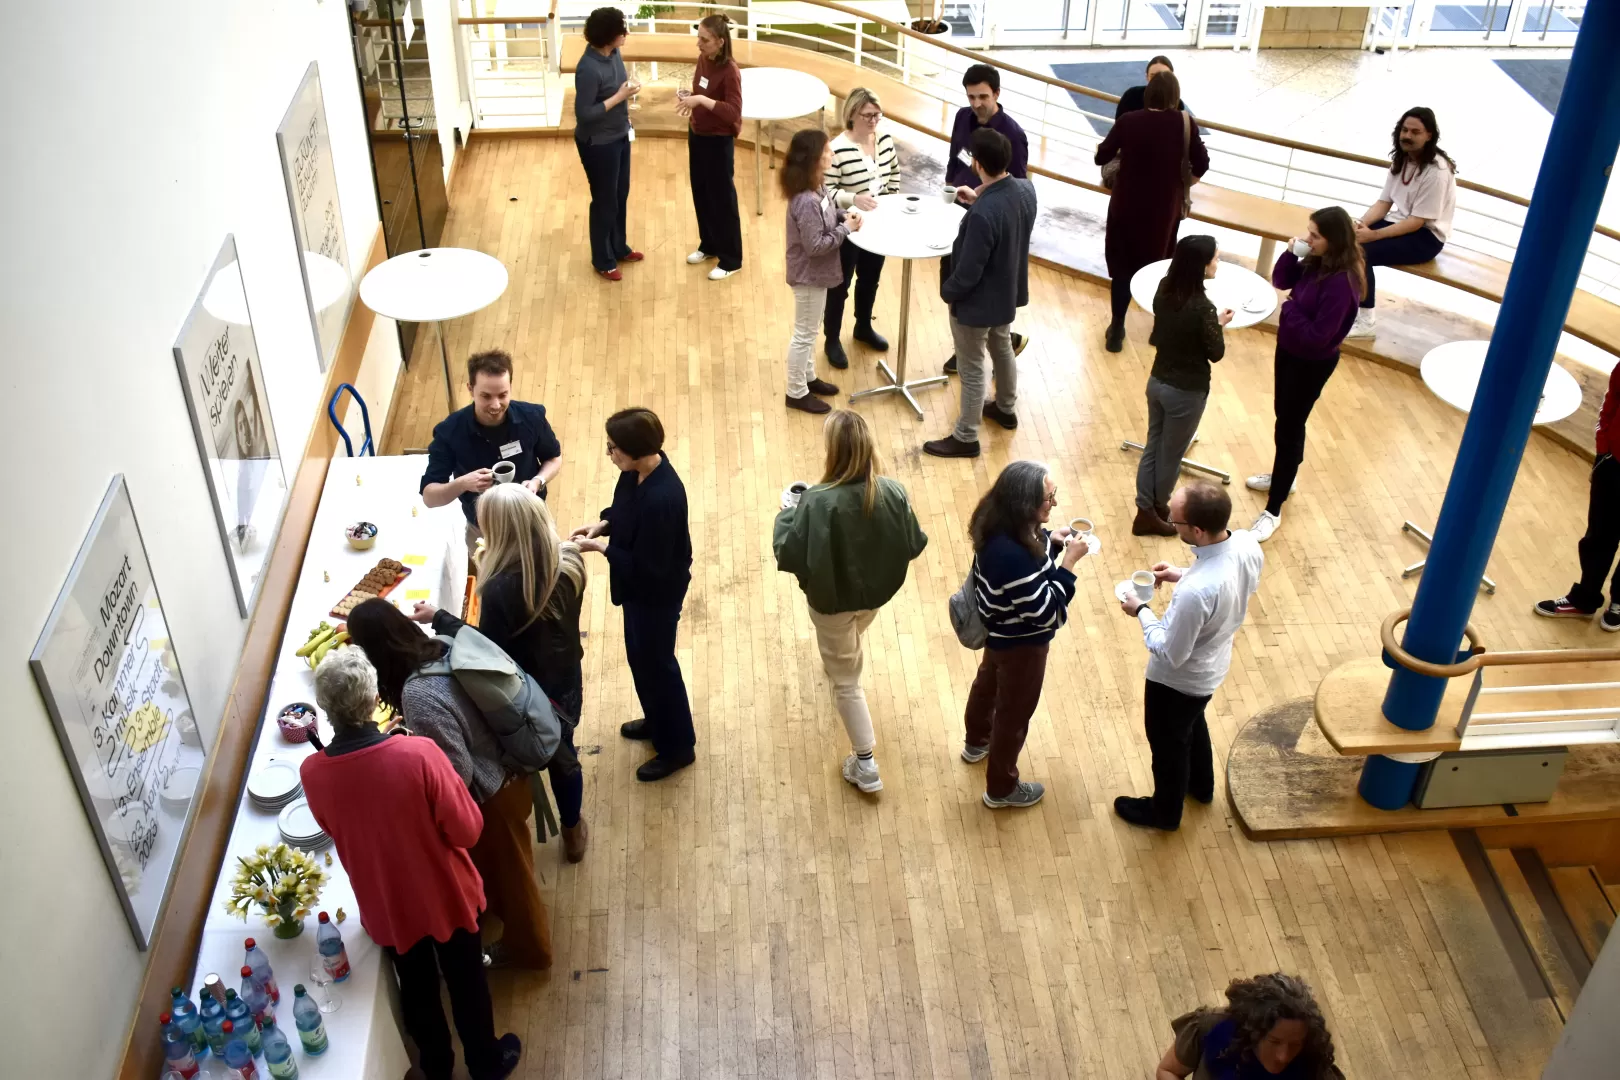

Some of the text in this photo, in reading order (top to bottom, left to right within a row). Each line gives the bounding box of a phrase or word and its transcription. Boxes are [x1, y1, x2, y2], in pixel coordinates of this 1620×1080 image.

[200, 326, 232, 396] Weiter
[210, 354, 239, 427] spielen
[99, 554, 132, 628] Mozart
[93, 580, 138, 685] Downtown
[115, 681, 138, 742] musik
[143, 769, 159, 821] April
[139, 818, 158, 872] 2023
